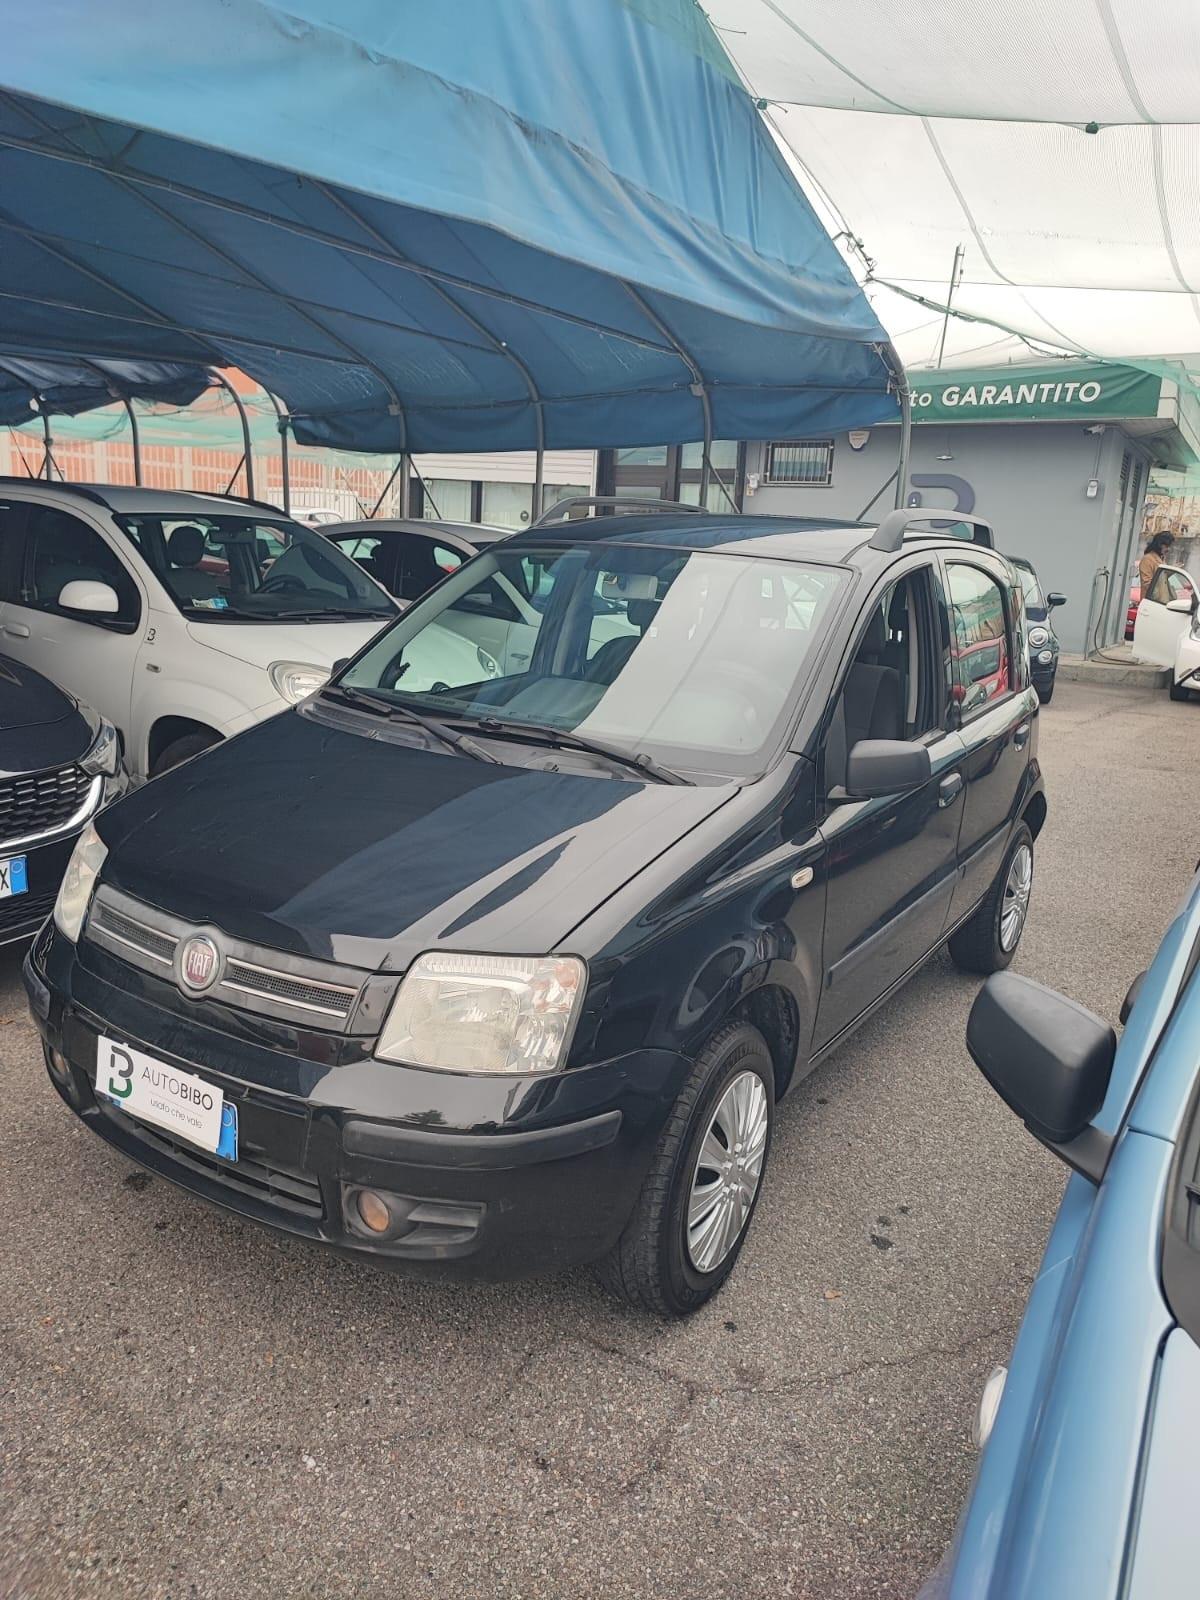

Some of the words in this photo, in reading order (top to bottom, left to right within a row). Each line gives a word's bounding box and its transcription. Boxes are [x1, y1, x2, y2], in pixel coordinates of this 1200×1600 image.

[942, 381, 1101, 407] GARANTITO
[187, 950, 211, 978] FIAT
[141, 1066, 213, 1110] AUTOBIBO
[150, 1098, 170, 1114] usato
[170, 1107, 186, 1121] che
[186, 1114, 203, 1129] vale
